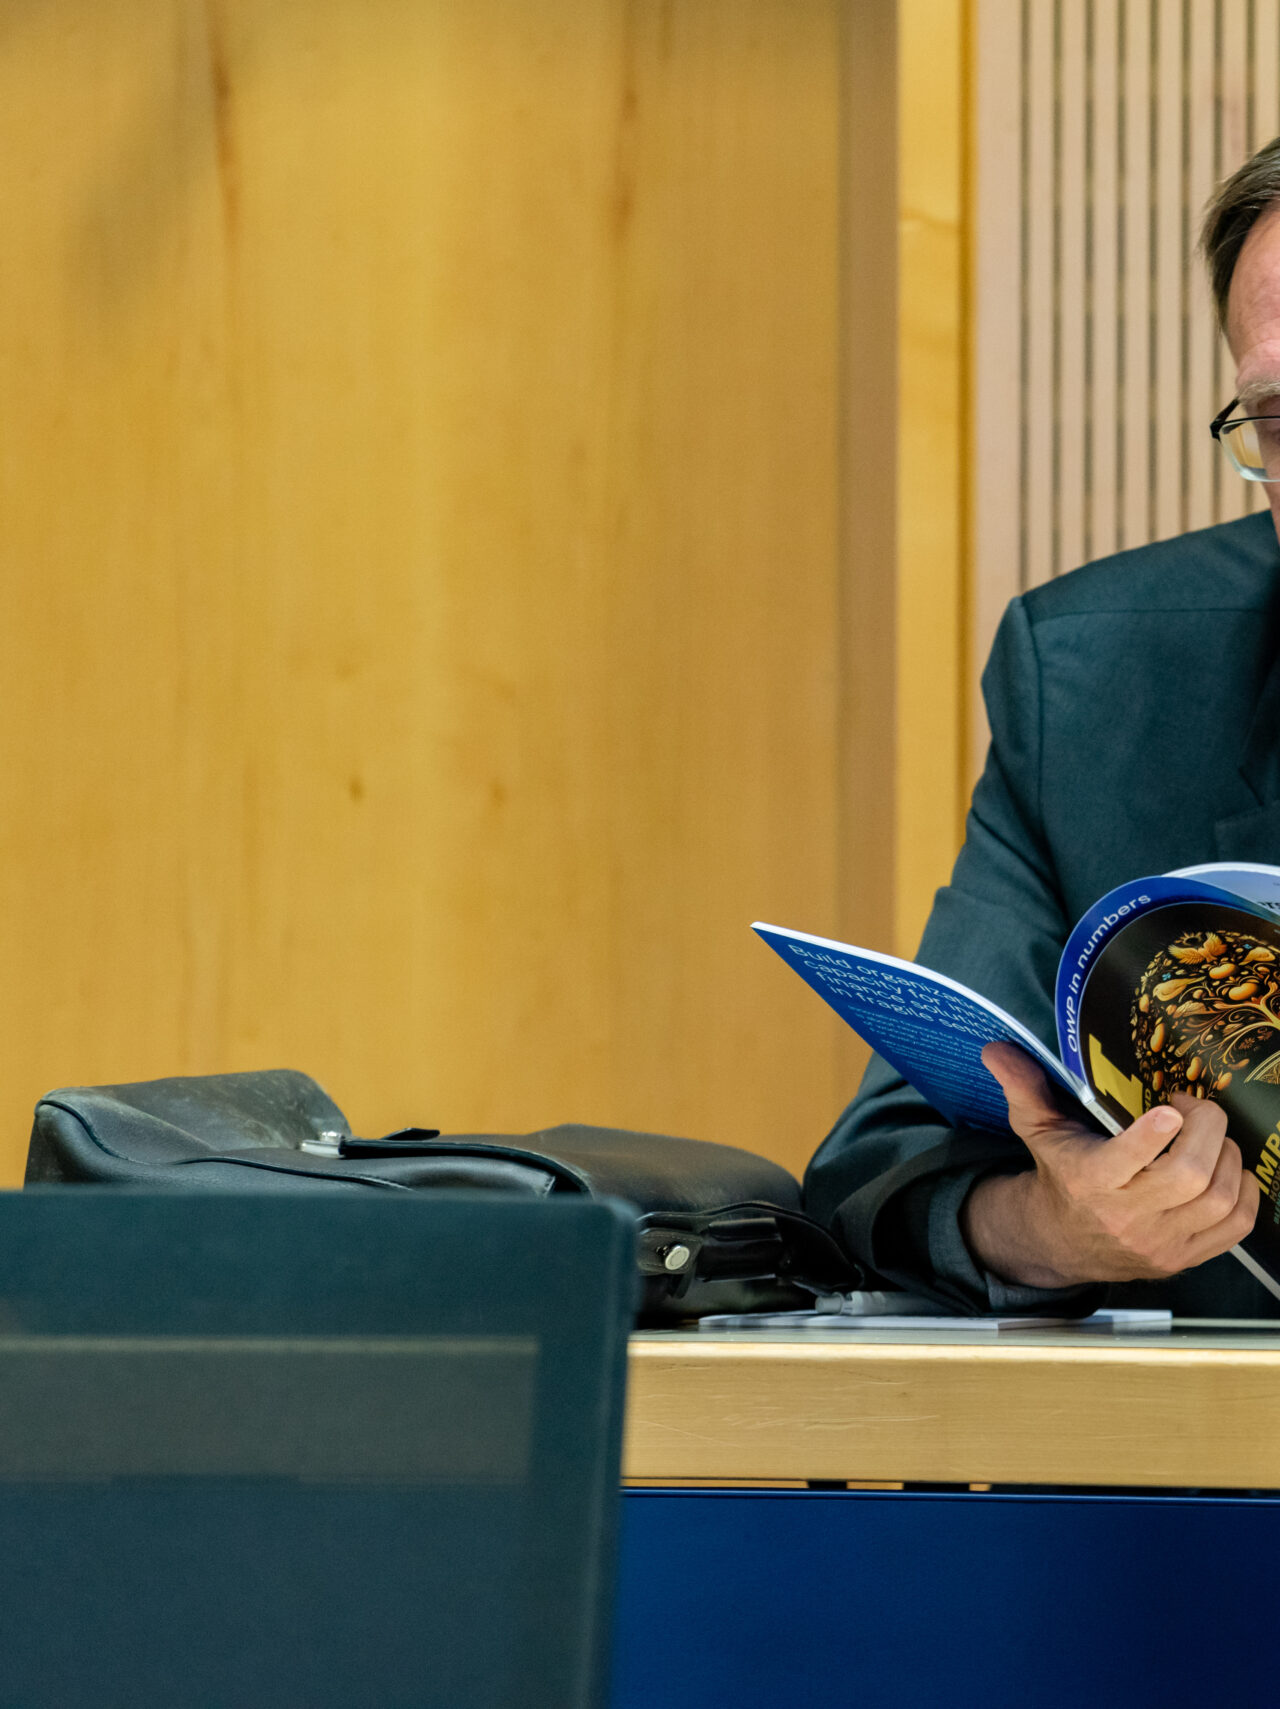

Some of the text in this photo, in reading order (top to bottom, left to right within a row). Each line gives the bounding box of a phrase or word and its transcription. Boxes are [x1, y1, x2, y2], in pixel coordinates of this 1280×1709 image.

[787, 944, 852, 970] Build
[1065, 894, 1152, 1053] OWP in numbers
[803, 960, 941, 1006] capacity for
[815, 971, 906, 1005] finance
[829, 985, 853, 999] in
[856, 992, 934, 1022] fragile
[938, 1018, 998, 1042] settin
